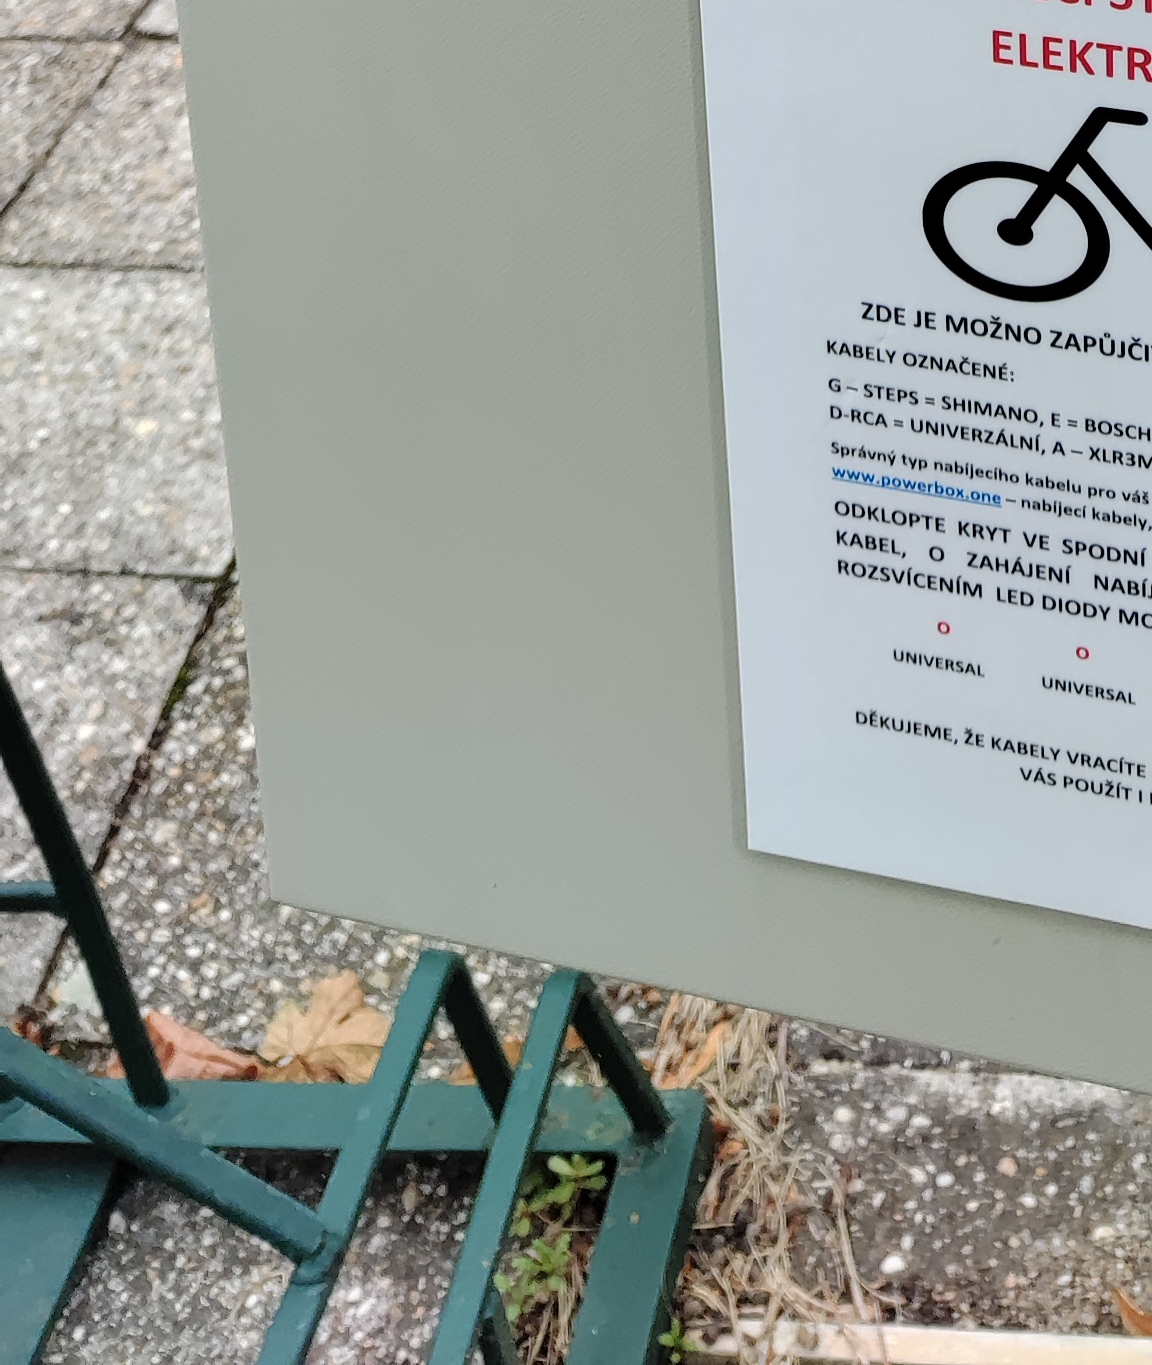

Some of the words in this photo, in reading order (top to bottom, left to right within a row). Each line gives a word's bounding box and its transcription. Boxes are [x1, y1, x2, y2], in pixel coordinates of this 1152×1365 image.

[861, 302, 906, 326] ZDE
[913, 310, 936, 330] JE
[946, 314, 1042, 345] MOŽNO
[827, 340, 896, 364] KABELY
[903, 352, 1014, 382] OZNAČENÉ:
[828, 378, 841, 393] G
[864, 383, 918, 405] STEPS
[942, 396, 1044, 428] SHIMANO,
[1051, 412, 1061, 428] E
[830, 405, 888, 428] D-RCA
[911, 418, 1045, 456] UNIVERZÁLNÍ,
[1052, 441, 1065, 456] A
[831, 442, 896, 466] Správný
[901, 454, 928, 471] typ
[934, 461, 1019, 484] nabíjecího
[1026, 472, 1081, 494] kabelu
[1088, 486, 1116, 499] pro
[1122, 490, 1149, 505] váš
[832, 466, 1002, 507] www.powerbox.one
[1021, 498, 1086, 519] nabíjecí
[1092, 507, 1152, 531] kabely,
[834, 500, 945, 534] ODKLOPTE
[958, 520, 1011, 544] KRYT
[1023, 531, 1050, 551] VE
[1062, 539, 1147, 567] SPODNÍ
[836, 530, 906, 559] KABEL,
[929, 546, 944, 562] O
[967, 552, 1071, 585] ZAHÁJENÍ
[838, 559, 982, 599] ROZSVÍCENÍM
[997, 587, 1034, 607] LED
[1042, 595, 1111, 621] DIODY
[893, 649, 984, 677] UNIVERSAL
[1042, 676, 1136, 705] UNIVERSAL
[856, 710, 958, 745] DĚKUJEME,
[964, 728, 984, 748] ŽE
[991, 736, 1060, 761] KABELY
[1067, 750, 1146, 778] VRACÍTE
[1020, 767, 1057, 786] VÁS
[1063, 775, 1132, 800] POUŽÍT
